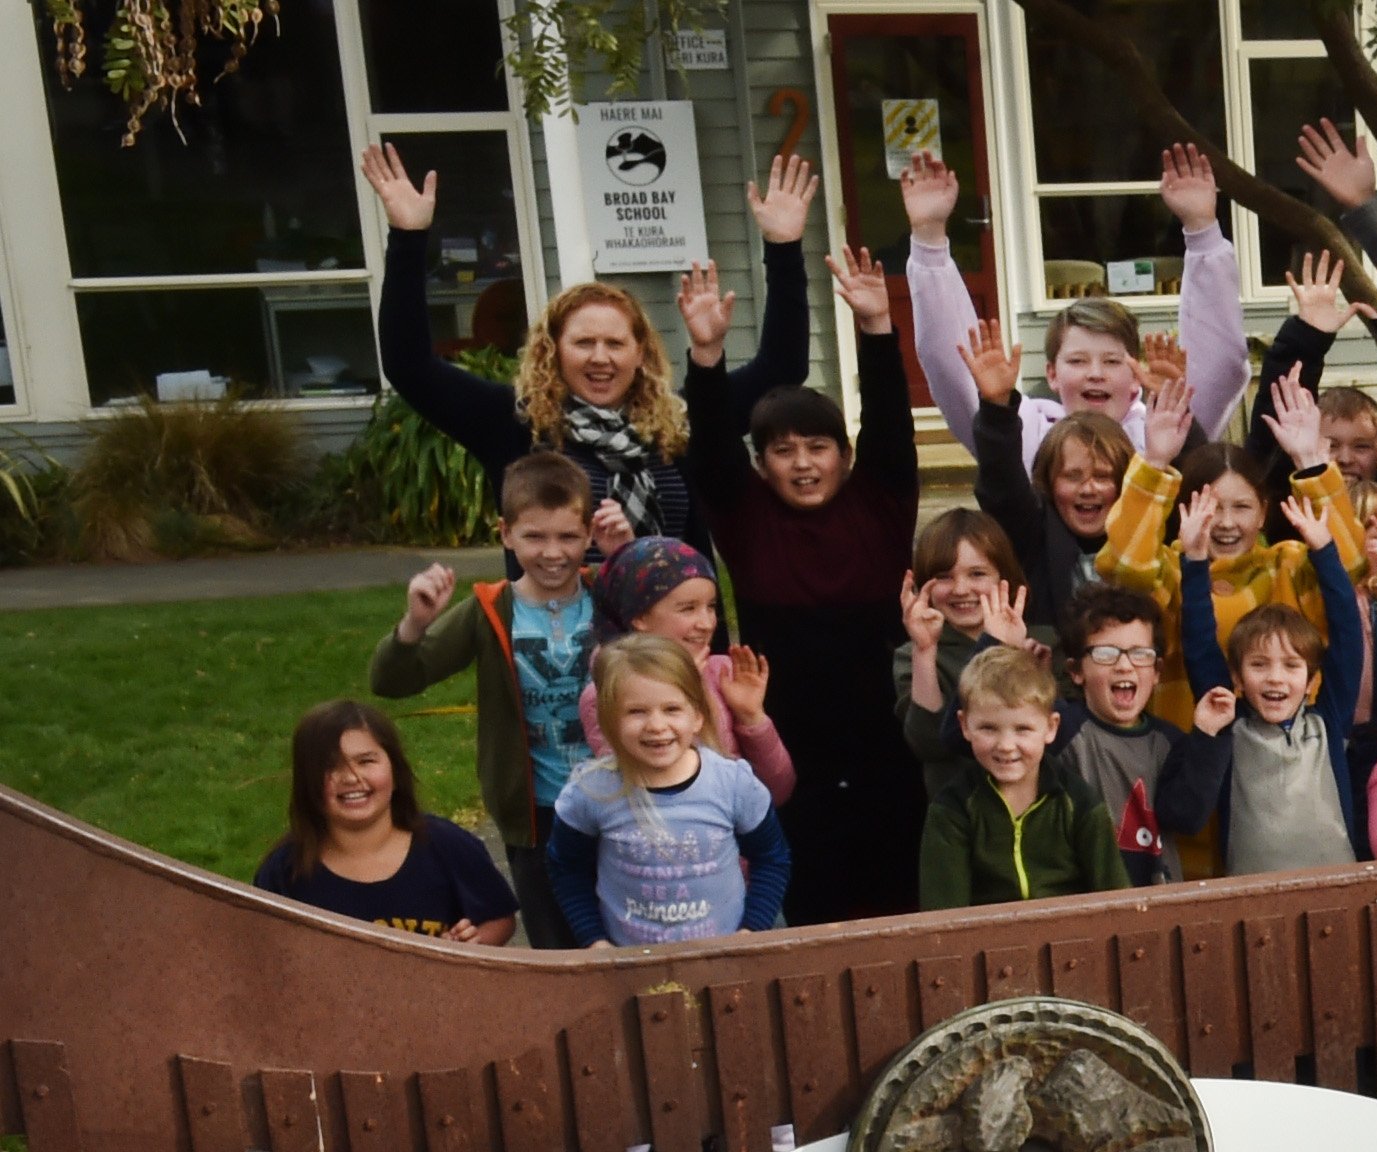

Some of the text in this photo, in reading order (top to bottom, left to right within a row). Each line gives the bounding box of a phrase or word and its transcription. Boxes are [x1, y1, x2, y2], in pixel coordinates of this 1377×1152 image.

[600, 107, 663, 121] HAERE MAI
[604, 191, 676, 206] BROAD BAY
[616, 207, 667, 221] SCHOOL
[624, 225, 665, 238] TE KURA
[605, 236, 686, 249] WHAKAOHORAHI
